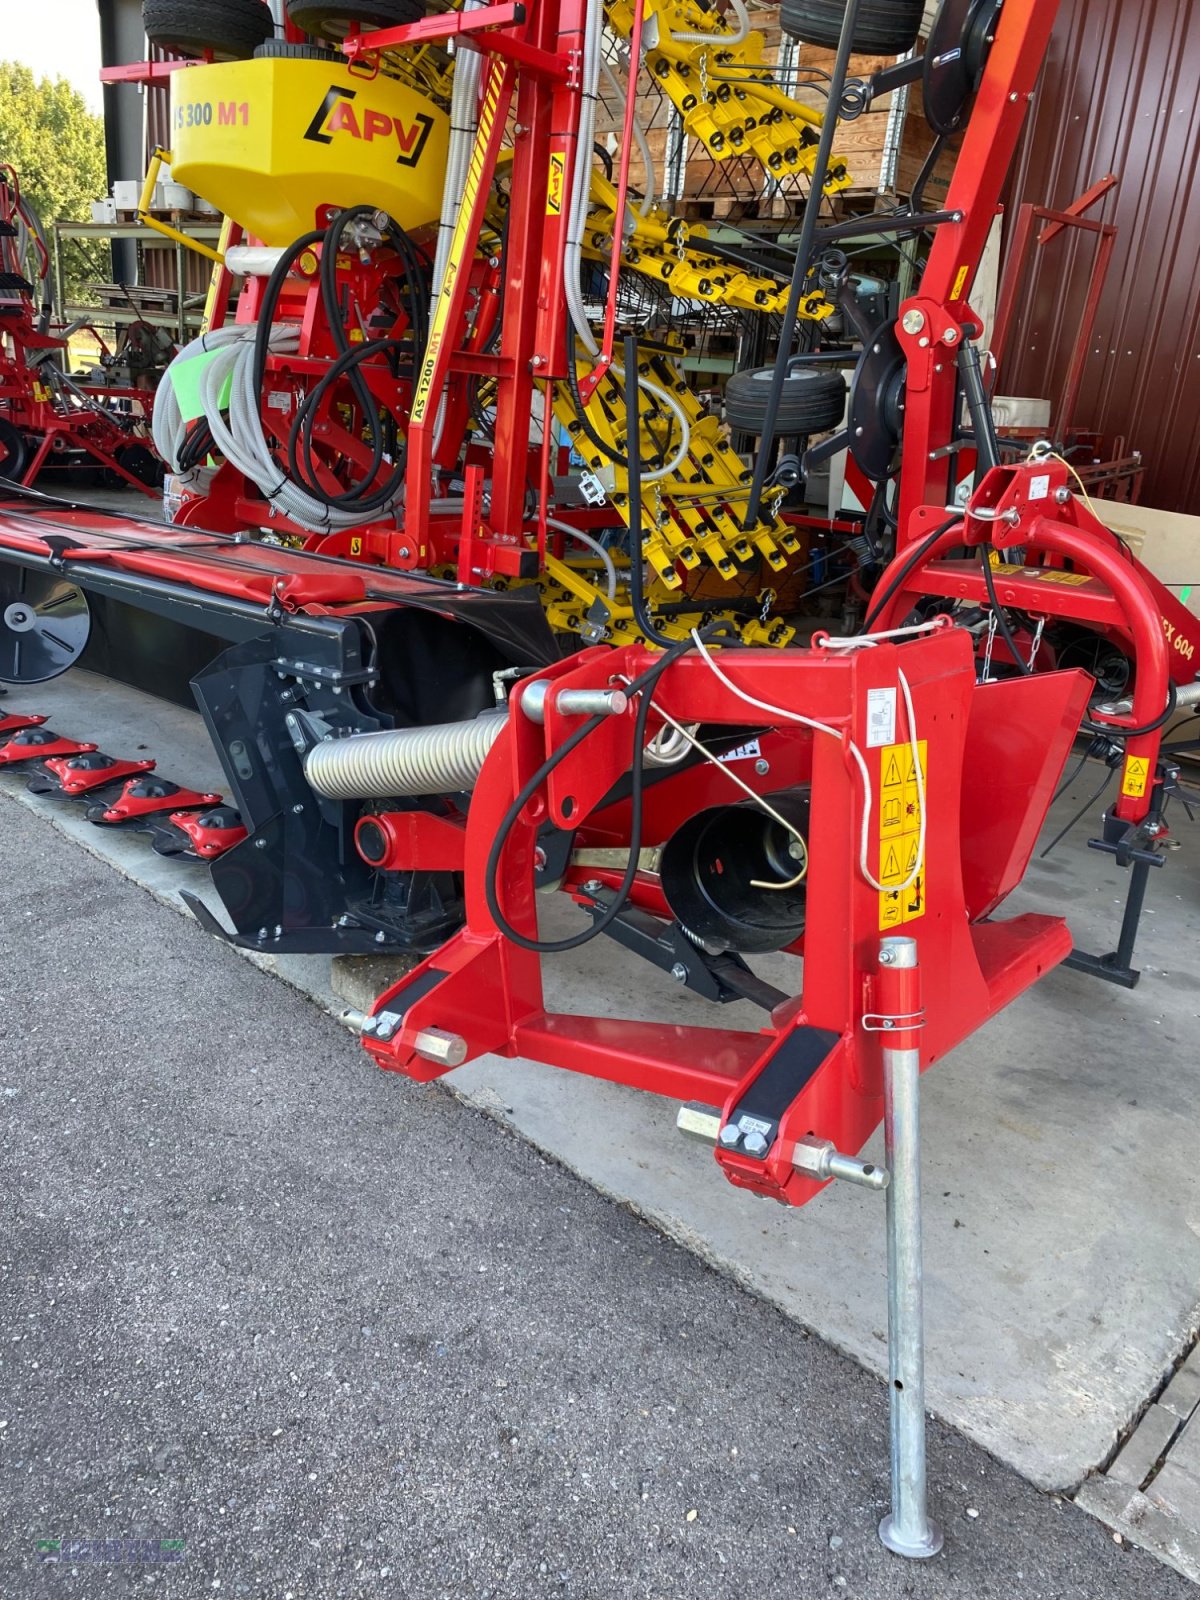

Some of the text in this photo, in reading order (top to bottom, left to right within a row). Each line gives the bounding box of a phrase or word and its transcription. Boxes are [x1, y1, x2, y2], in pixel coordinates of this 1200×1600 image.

[186, 102, 213, 127] 300
[218, 101, 250, 126] M1
[414, 332, 441, 420] AS 1200 M1
[1174, 634, 1194, 661] 604
